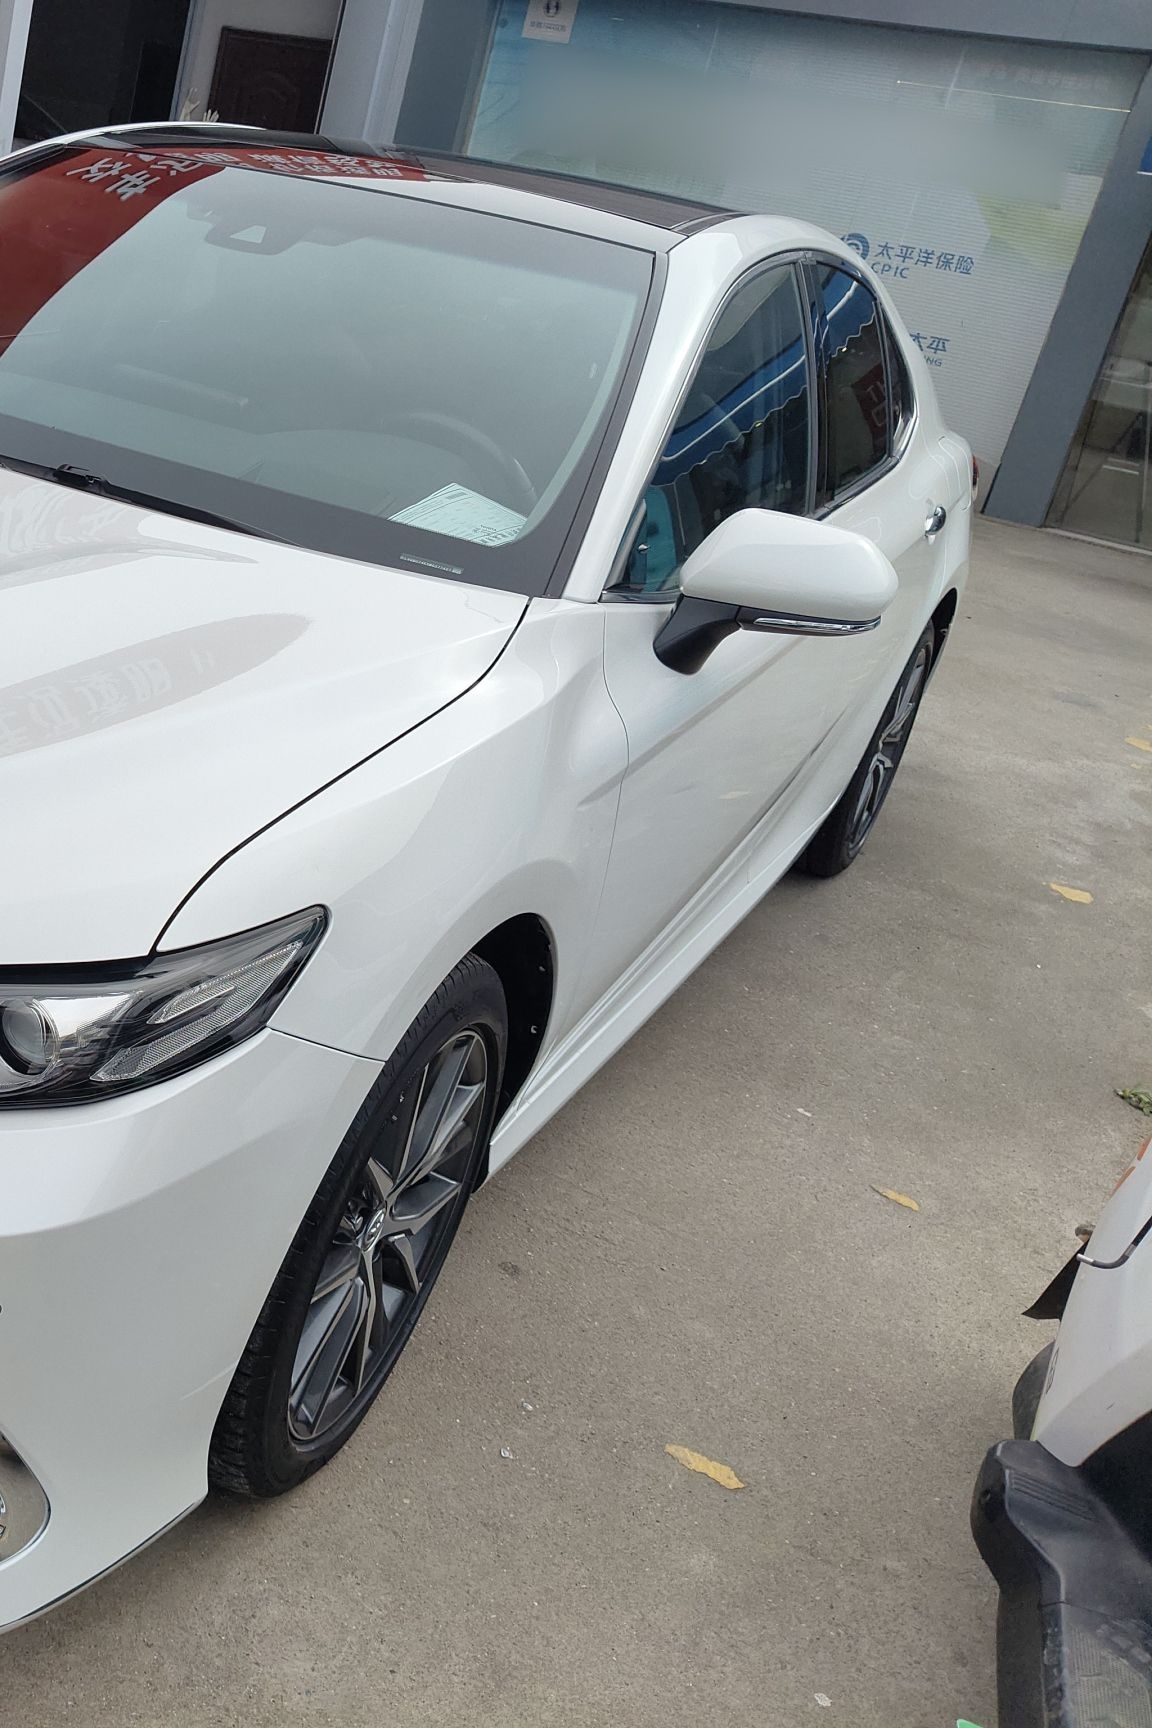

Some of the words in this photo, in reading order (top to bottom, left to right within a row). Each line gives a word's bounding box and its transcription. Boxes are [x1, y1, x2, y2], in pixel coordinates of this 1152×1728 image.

[871, 261, 910, 279] CPIC
[874, 242, 974, 274] 太平洋保险
